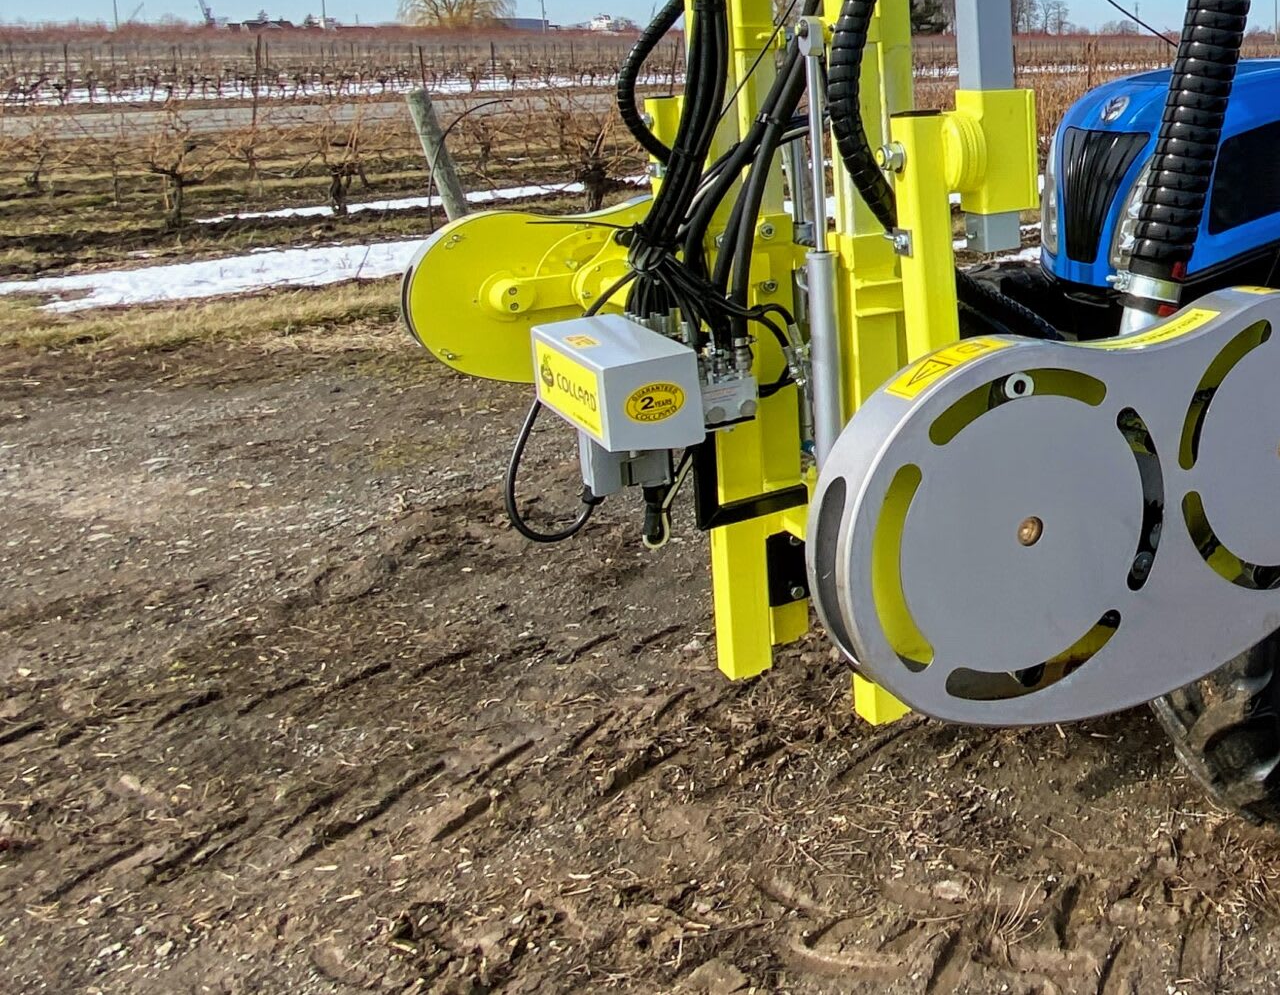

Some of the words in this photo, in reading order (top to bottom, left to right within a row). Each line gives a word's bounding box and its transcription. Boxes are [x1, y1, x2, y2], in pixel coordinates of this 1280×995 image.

[556, 373, 597, 412] COLLARD
[631, 384, 678, 402] GUARANTEED
[640, 396, 655, 411] 2
[655, 398, 673, 408] YEARS
